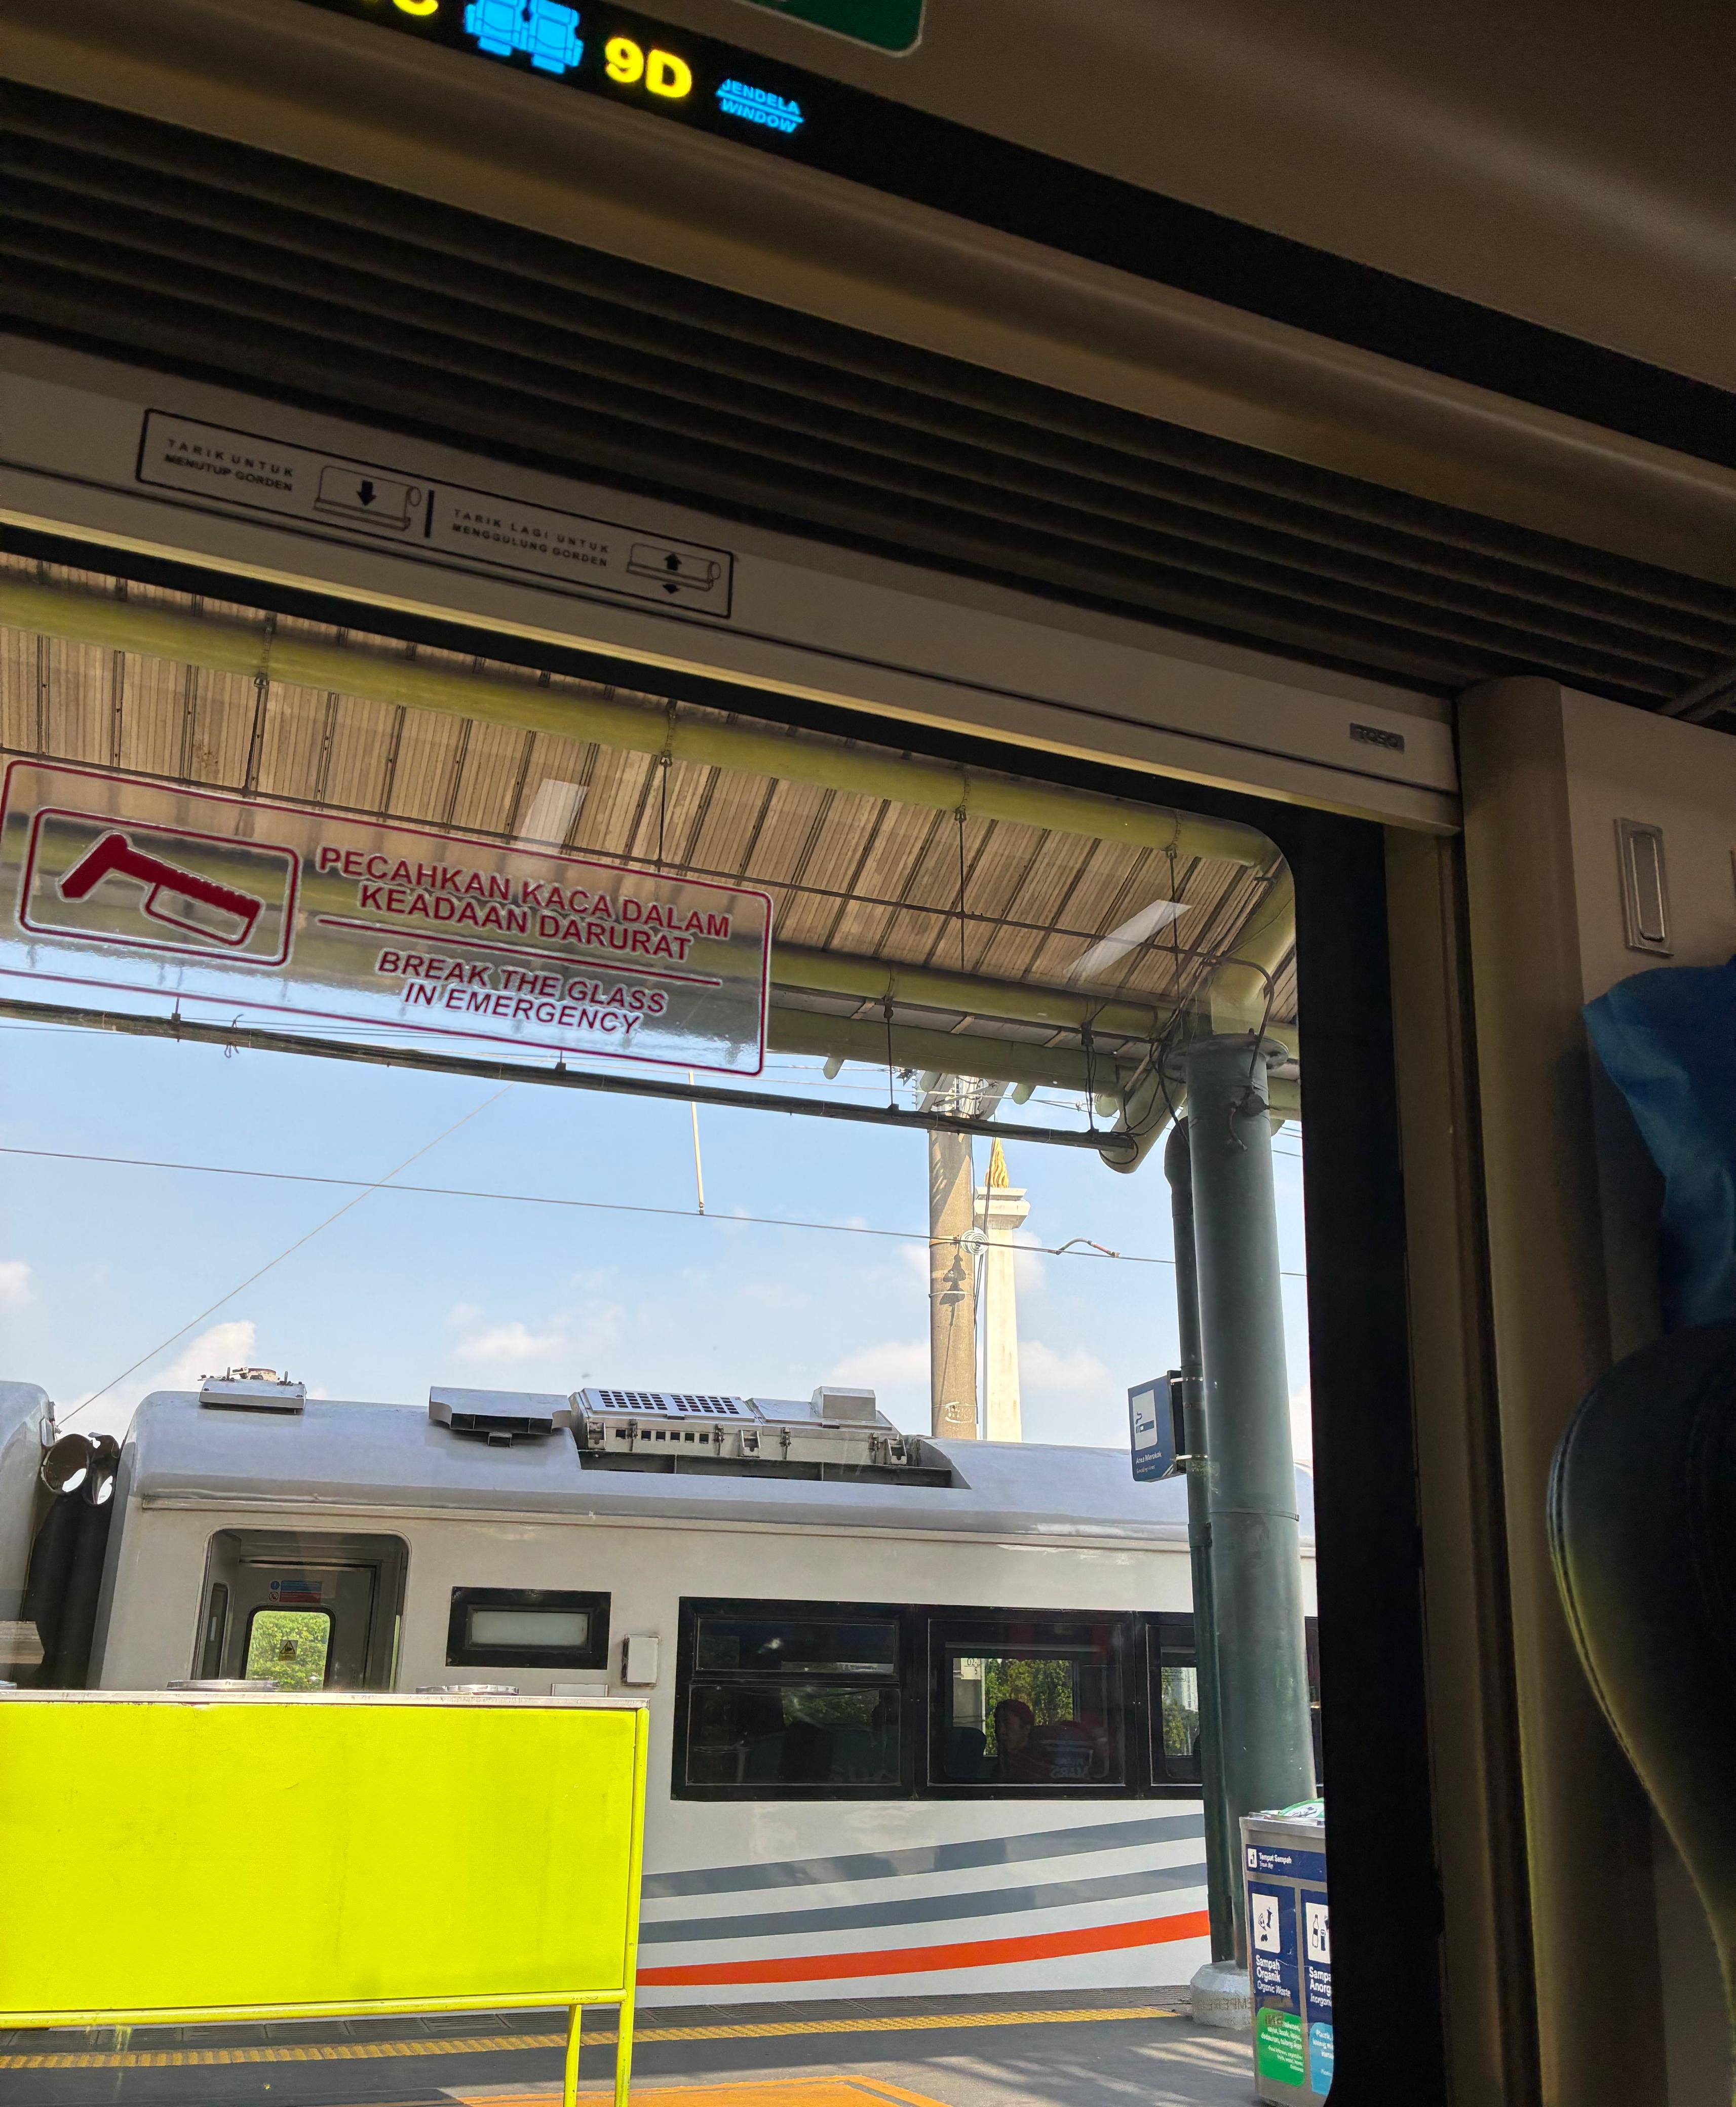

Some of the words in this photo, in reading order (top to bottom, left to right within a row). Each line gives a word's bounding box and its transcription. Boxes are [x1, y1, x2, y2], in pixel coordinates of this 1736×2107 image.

[604, 37, 692, 98] 9D
[720, 98, 797, 133] WINDOW
[721, 78, 800, 115] JENDELA
[165, 453, 232, 475] MENUTUP
[235, 471, 292, 491] GORDEN
[168, 438, 224, 460] TARIK
[231, 455, 293, 478] UNTUK
[452, 523, 548, 553] MENGGULUNG
[552, 547, 607, 567] GORDEN
[454, 509, 501, 528] TARIK
[511, 523, 549, 539] LAGI
[557, 534, 608, 554] UNTUK
[318, 846, 511, 901] PECAHKAN
[521, 881, 612, 918] KACA
[622, 899, 729, 939] DALAM
[361, 884, 527, 933] KEADAAN
[539, 914, 692, 960] DARURAT
[378, 951, 490, 987] BREAK
[500, 969, 561, 997] THE
[567, 981, 666, 1013] GLASS
[404, 982, 437, 1006] IN
[445, 988, 640, 1034] EMERGENCY
[1255, 1954, 1281, 1971] Sampah
[1256, 1966, 1281, 1982] Organik
[1309, 1966, 1331, 1983] Sampa
[1309, 1978, 1332, 1997] Anorg
